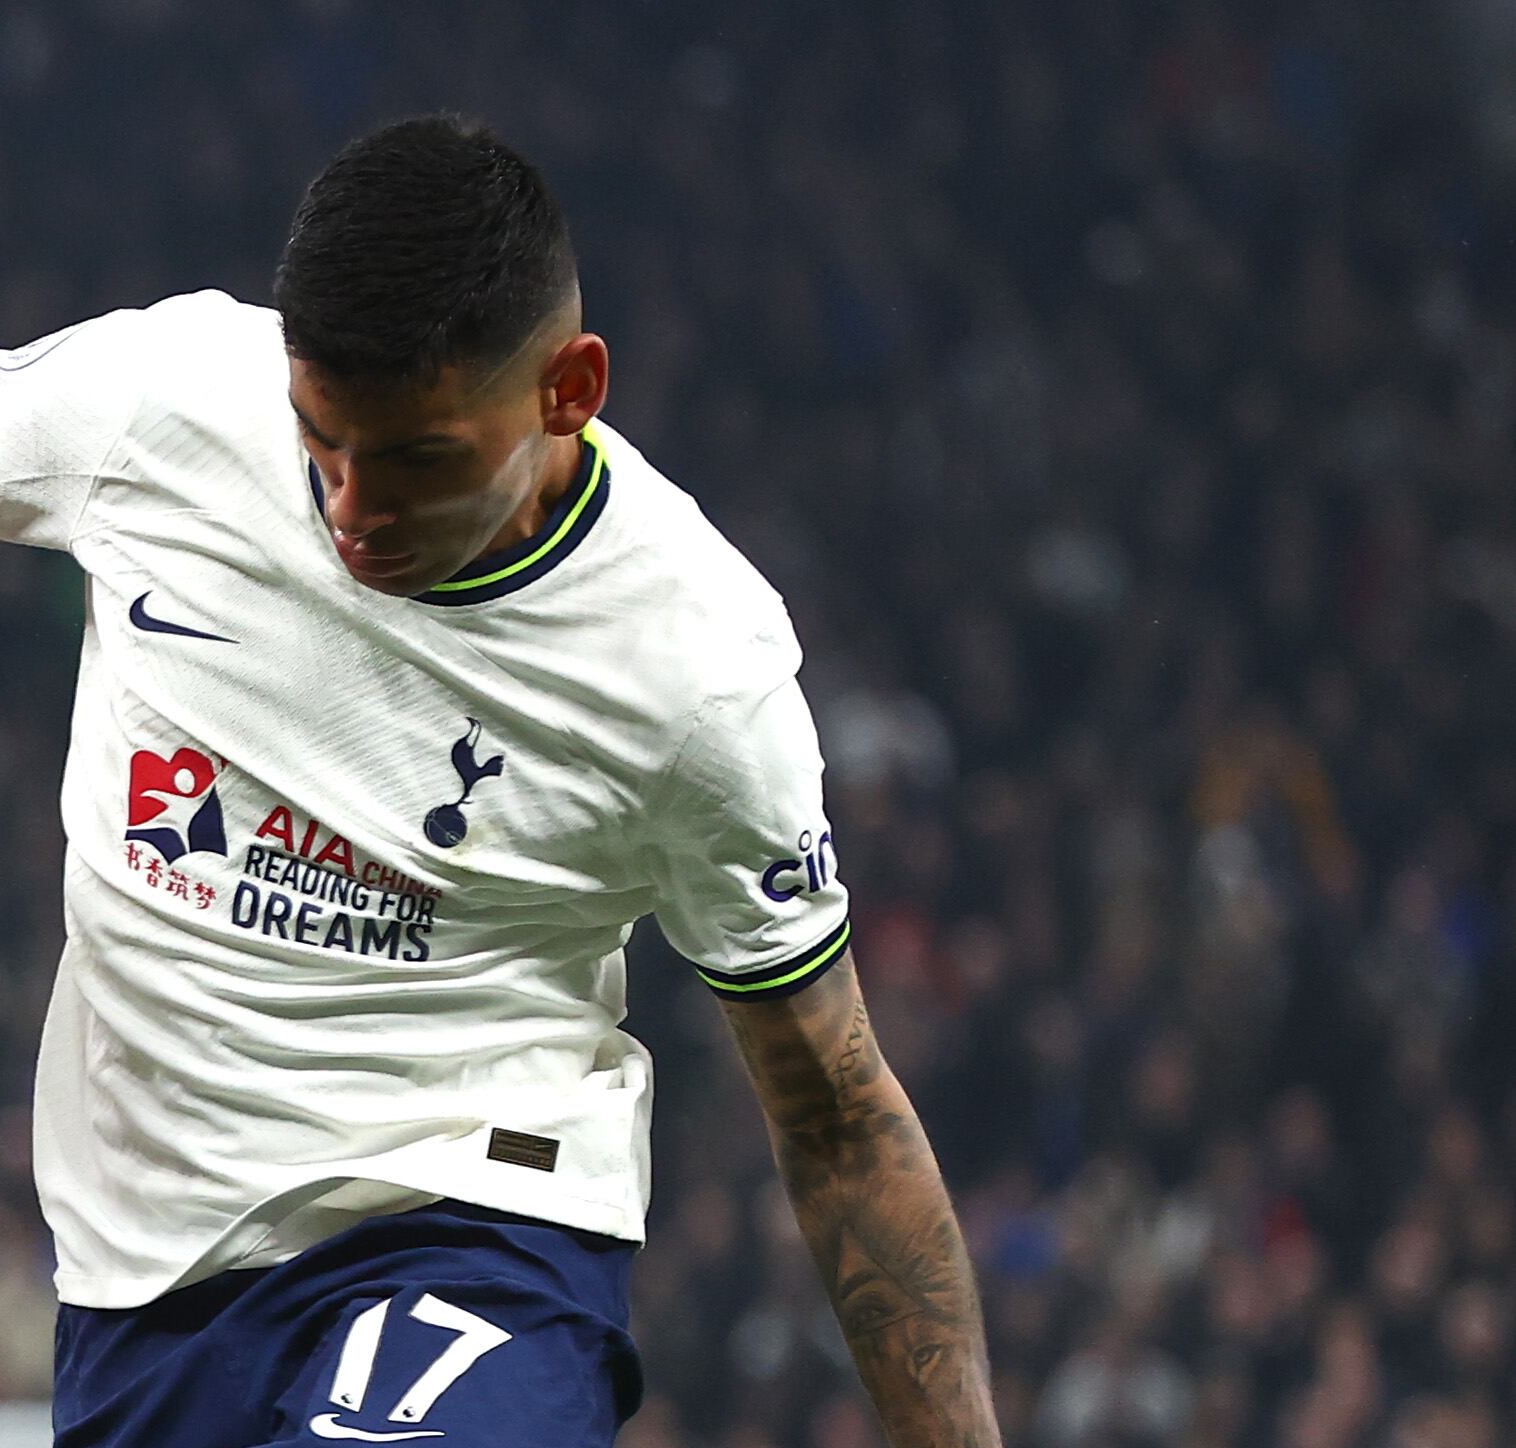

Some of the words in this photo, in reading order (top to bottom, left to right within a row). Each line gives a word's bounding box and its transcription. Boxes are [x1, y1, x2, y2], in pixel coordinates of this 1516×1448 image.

[255, 805, 357, 877] AIA
[231, 879, 432, 963] DREAMS
[244, 844, 370, 911] READING
[378, 891, 435, 925] FOR
[329, 1292, 513, 1423] 17
